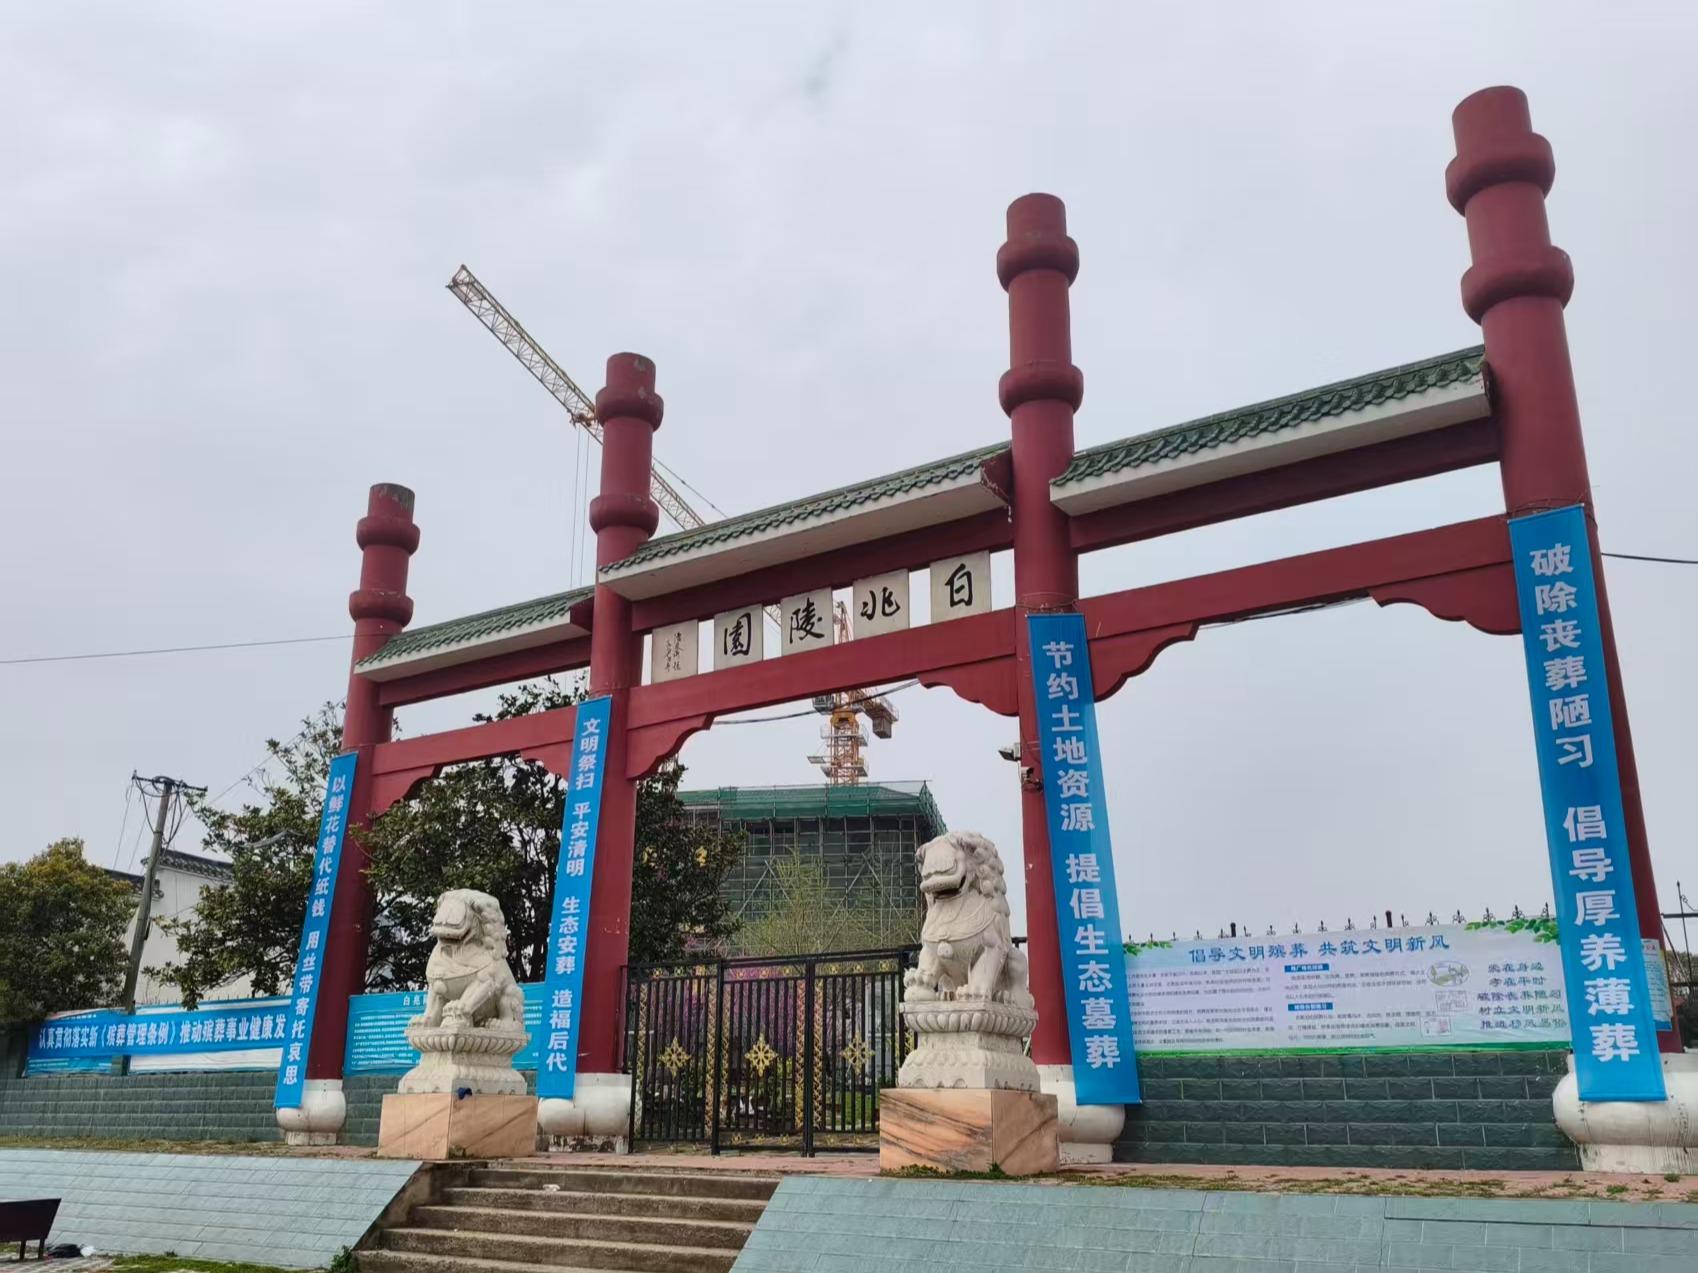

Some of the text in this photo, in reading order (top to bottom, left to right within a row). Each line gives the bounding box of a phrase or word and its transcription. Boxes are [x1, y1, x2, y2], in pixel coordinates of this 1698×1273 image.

[283, 775, 347, 1085] 以鲜花替代纸钱 用丝带寄托哀思
[546, 718, 601, 1072] 文明祭扫 平安清明 生态安葬 造福后代
[1042, 641, 1121, 1069] 节约土地资源 提倡生态墓葬
[1189, 934, 1450, 963] 倡导文明殡葬 共筑文明新风
[1529, 543, 1640, 1062] 破除丧葬陋习 倡导厚养薄葬
